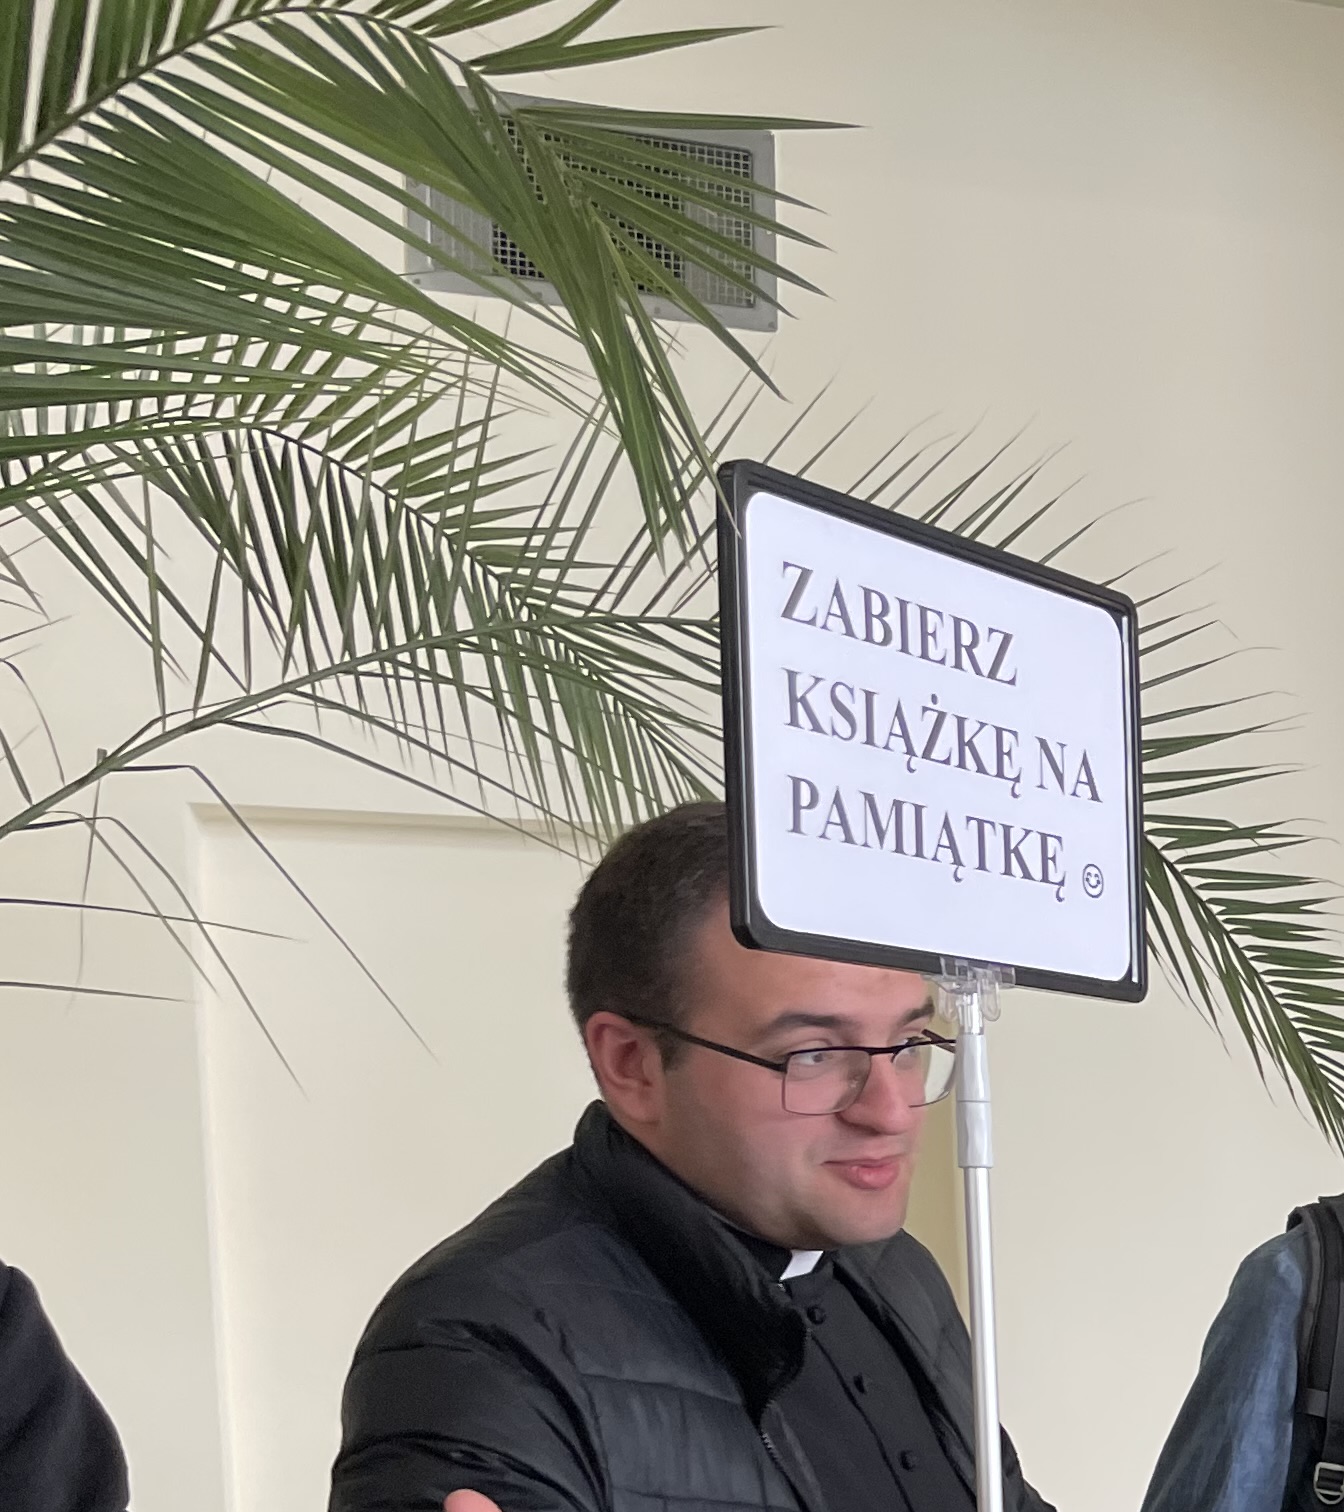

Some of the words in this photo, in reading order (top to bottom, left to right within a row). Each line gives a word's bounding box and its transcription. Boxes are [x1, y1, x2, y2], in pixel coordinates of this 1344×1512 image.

[780, 561, 1018, 687] ZABIERZ
[780, 668, 1021, 798] KSIĄŻKĘ
[1035, 735, 1103, 804] NA
[785, 774, 1066, 902] PAMIĄTKĘ
